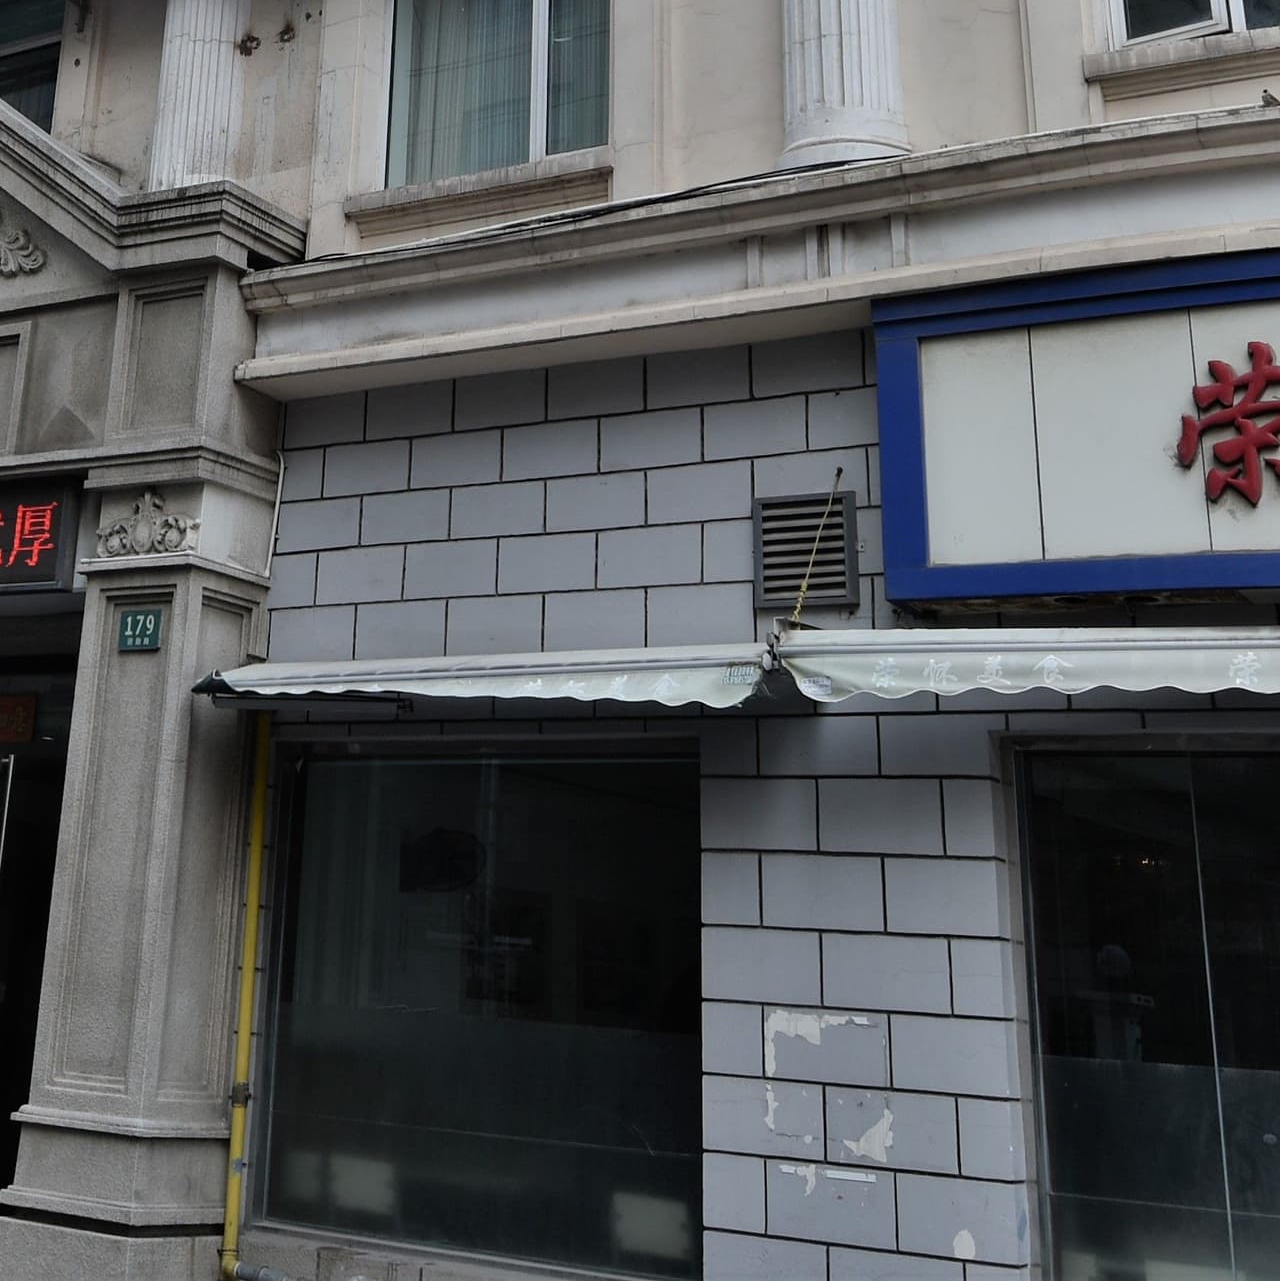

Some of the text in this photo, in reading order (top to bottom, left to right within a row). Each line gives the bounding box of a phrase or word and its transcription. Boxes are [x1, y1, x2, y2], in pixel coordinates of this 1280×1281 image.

[124, 614, 155, 636] 179
[871, 654, 1075, 689] 荣怀美食
